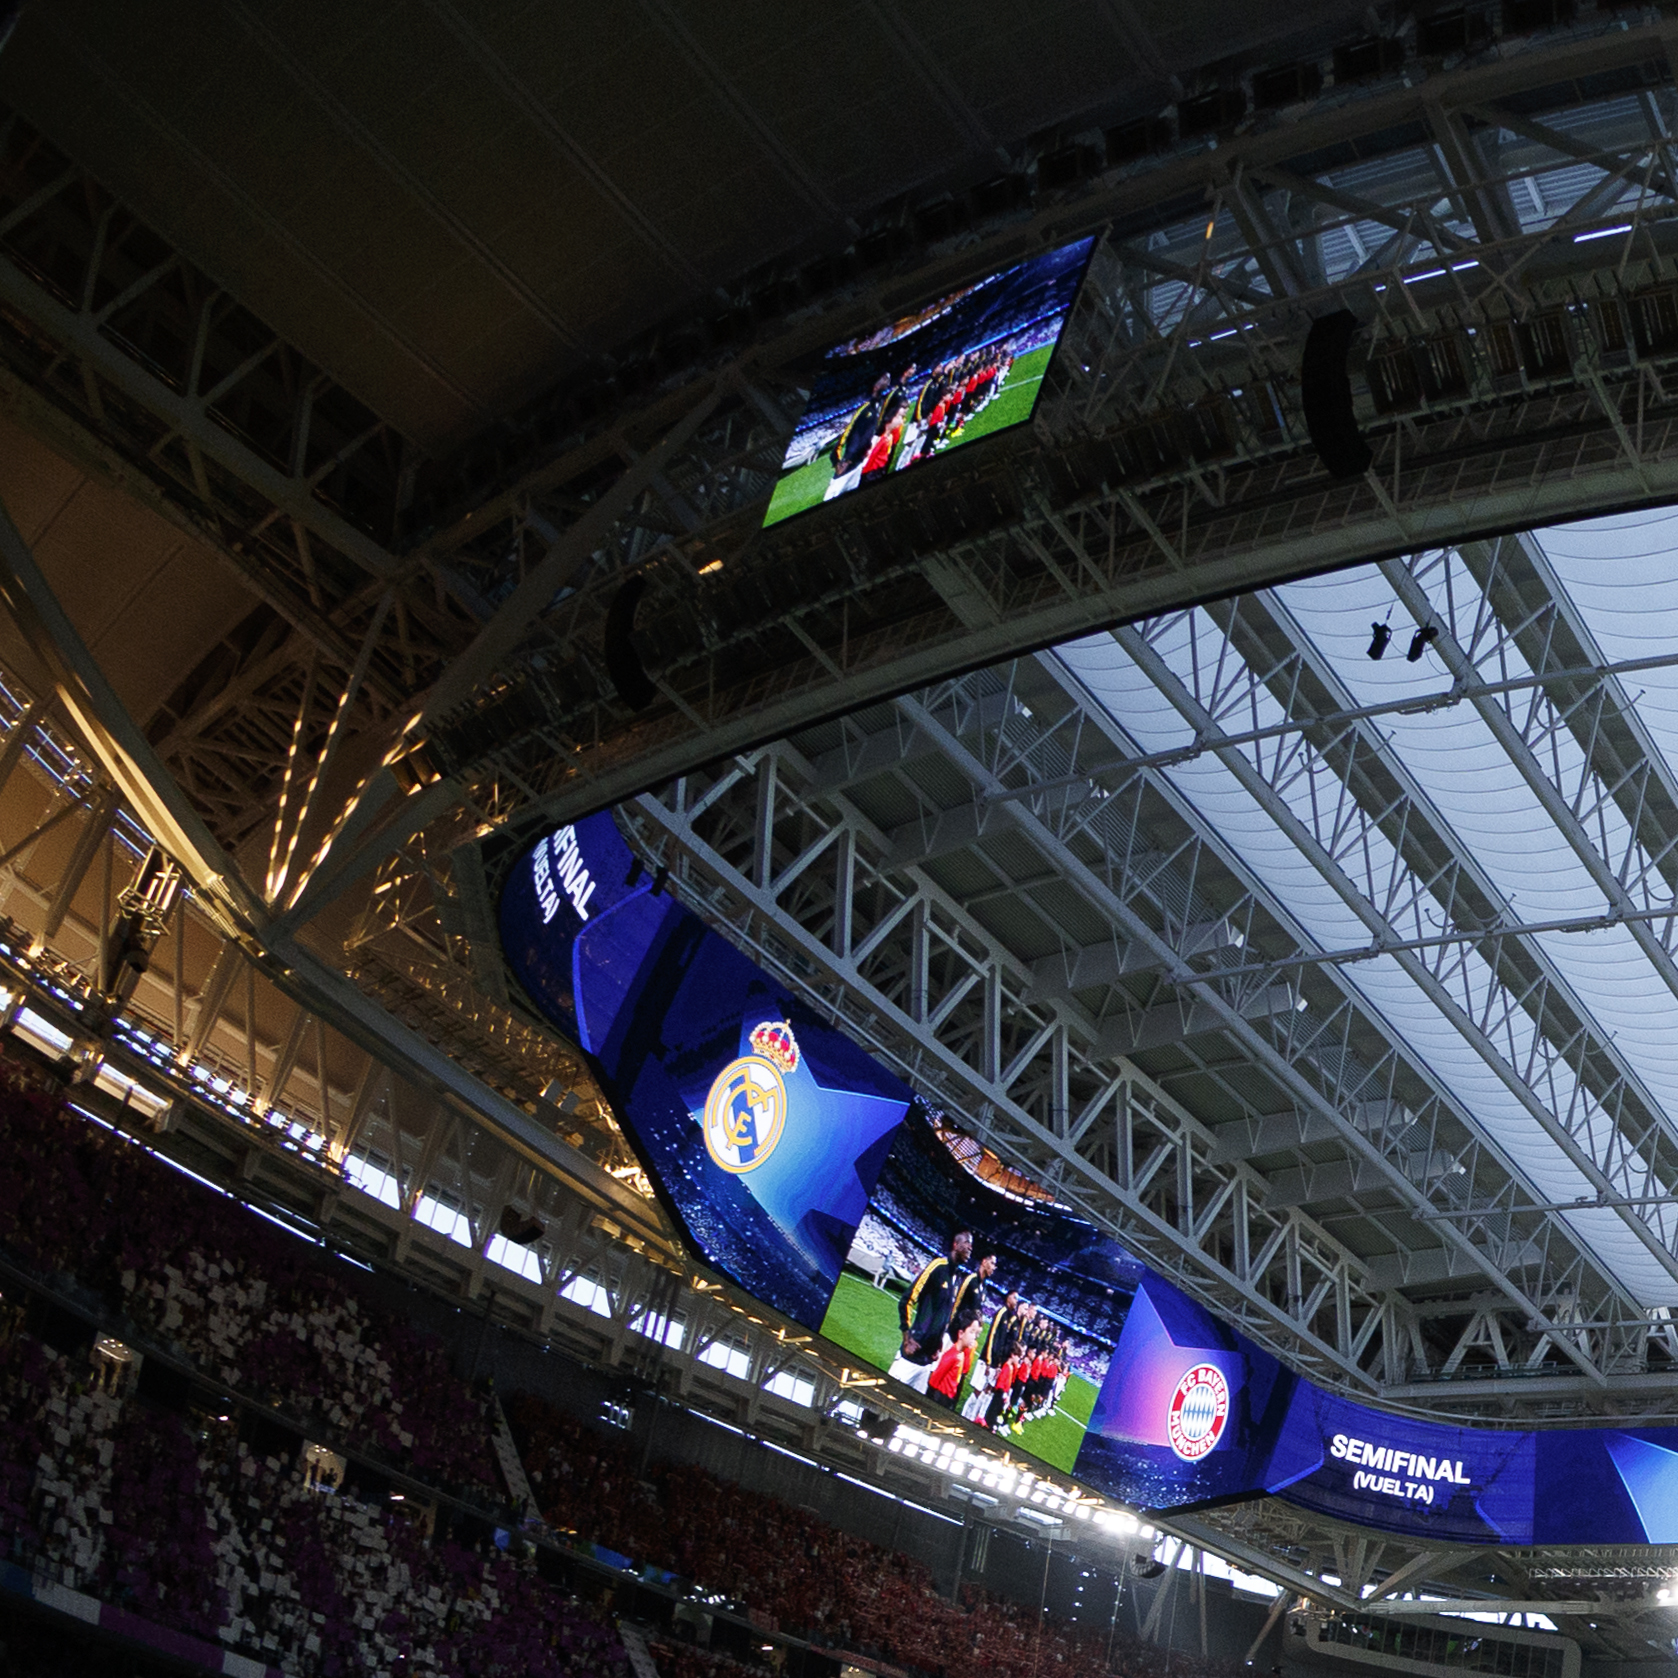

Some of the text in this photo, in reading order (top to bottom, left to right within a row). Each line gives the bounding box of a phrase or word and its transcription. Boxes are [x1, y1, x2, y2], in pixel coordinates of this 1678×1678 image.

[1180, 1369, 1226, 1416] FC BAYERN
[1330, 1434, 1471, 1484] SEMIFINAL
[1353, 1470, 1434, 1504] (VUELTA)
